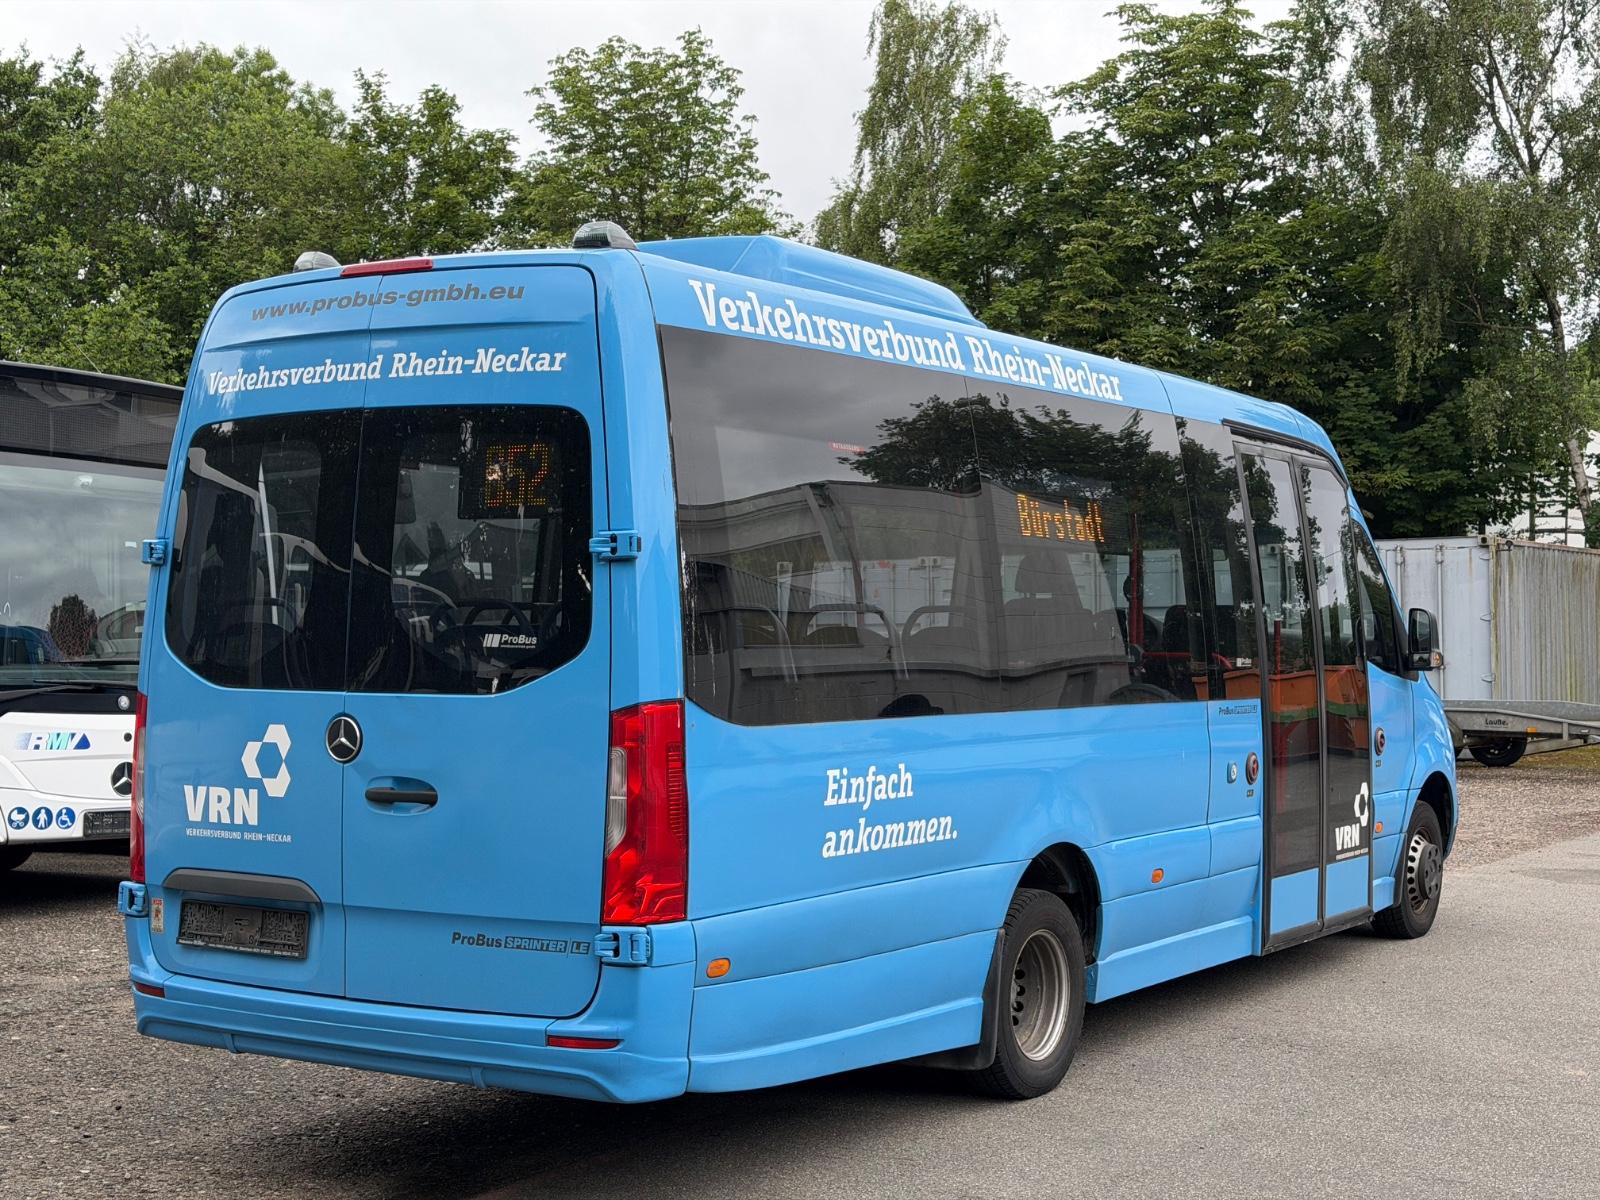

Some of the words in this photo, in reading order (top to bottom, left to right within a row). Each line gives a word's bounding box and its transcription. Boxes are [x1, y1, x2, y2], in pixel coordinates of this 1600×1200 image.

[251, 283, 525, 321] www.probus-gmbh.eu
[687, 279, 966, 371] Verkehrsverbund
[967, 335, 1123, 402] Rhein-Neckar
[207, 353, 382, 396] Verkehrsverbund
[388, 347, 567, 379] Rhein-Neckar
[1016, 493, 1105, 543] Bürstadt
[501, 634, 538, 645] ProBus
[183, 784, 259, 826] VRN
[823, 763, 913, 811] Einfach
[185, 827, 242, 840] VERKEHRSVERBUND
[243, 831, 293, 843] RHEIN-NECKAR
[822, 815, 958, 859] ankommen.
[1335, 822, 1361, 852] VRN
[451, 931, 503, 948] ProBus
[504, 936, 568, 953] SPRINTER
[571, 941, 591, 954] LE
